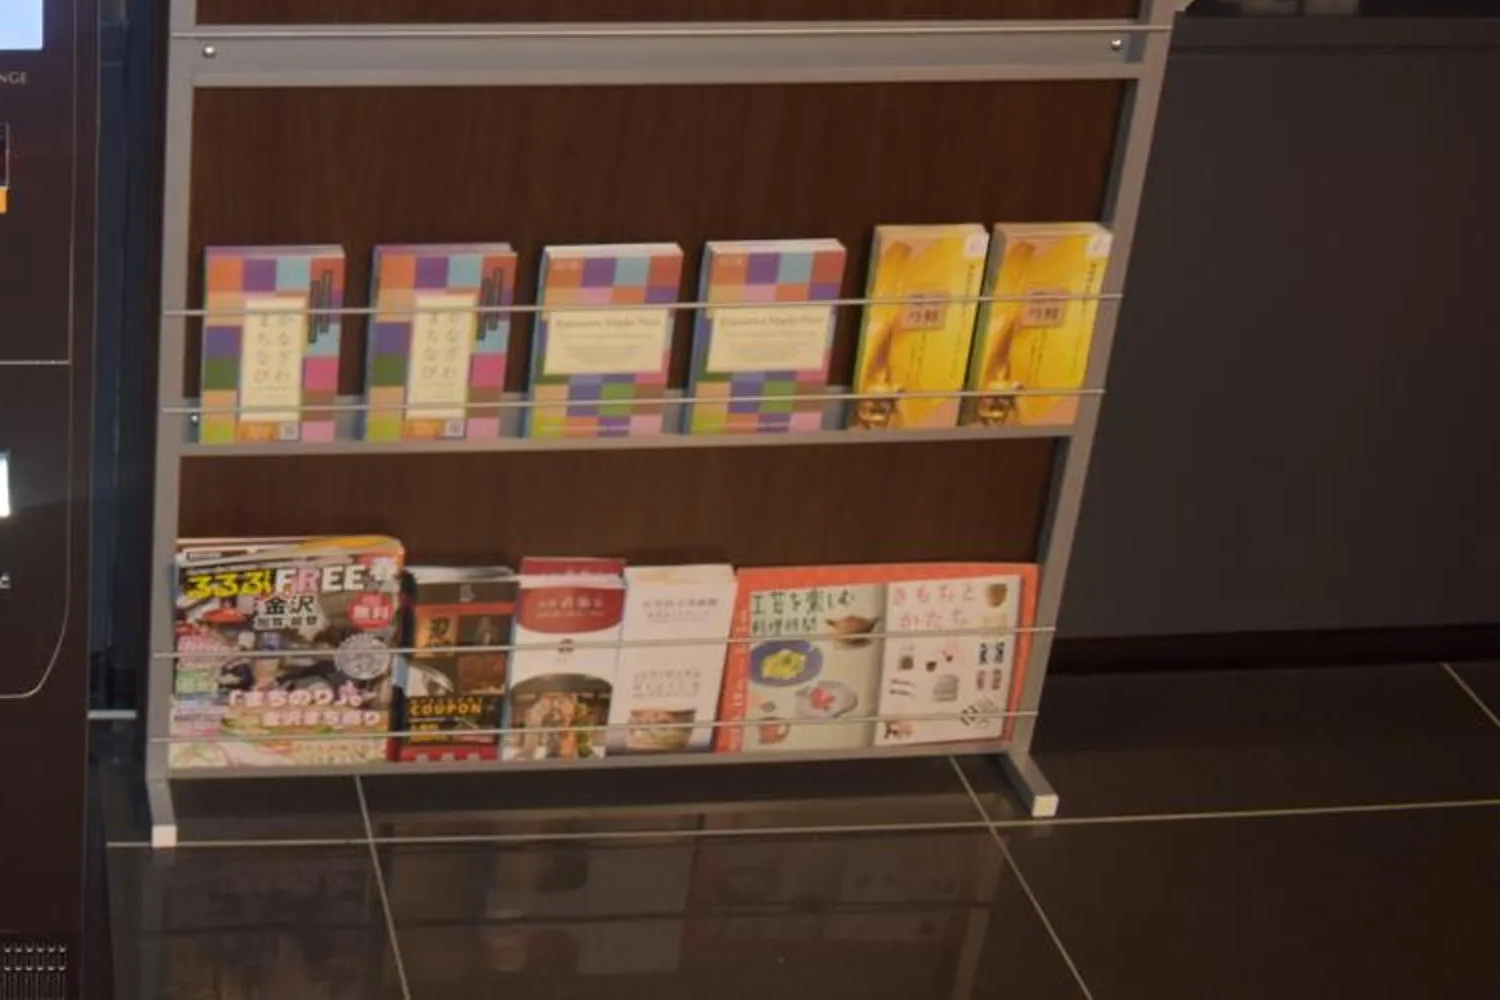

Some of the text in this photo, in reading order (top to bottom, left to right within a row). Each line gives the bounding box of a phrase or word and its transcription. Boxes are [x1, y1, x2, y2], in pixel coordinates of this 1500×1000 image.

[274, 566, 367, 595] FREE
[264, 596, 316, 615] 金沢
[410, 702, 483, 717] COUPON
